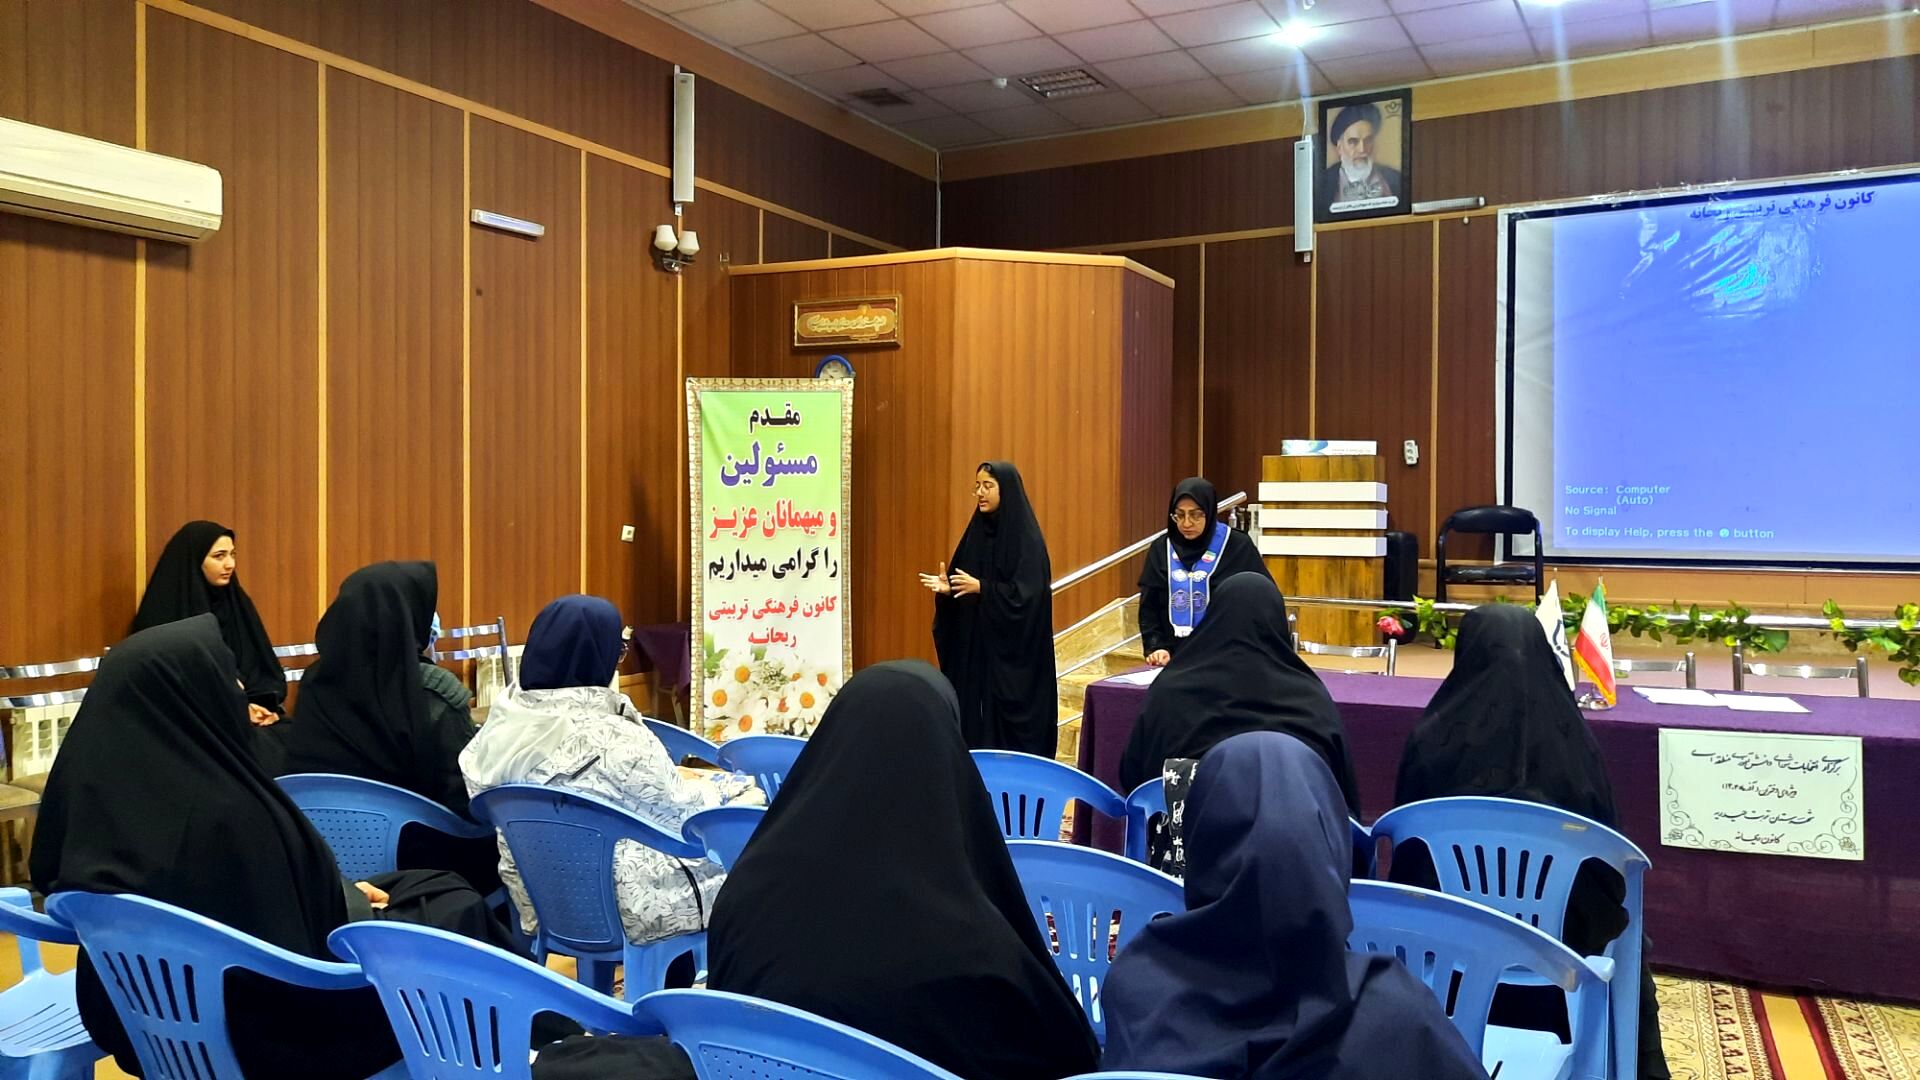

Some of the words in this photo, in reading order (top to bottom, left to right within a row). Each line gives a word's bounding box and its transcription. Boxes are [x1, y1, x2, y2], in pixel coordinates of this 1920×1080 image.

[1834, 191, 1875, 210] کانون
[749, 403, 801, 434] مقدم
[720, 441, 818, 486] مسئولین
[1565, 485, 1608, 495] Source:
[1616, 484, 1670, 496] Computer
[1616, 495, 1653, 505] (Auto)
[709, 506, 758, 538] عزیز
[762, 500, 824, 537] میهمانان
[1565, 506, 1580, 516] No
[1583, 506, 1617, 517] Signal
[828, 511, 837, 537] و
[1565, 527, 1578, 537] To
[1582, 527, 1620, 538] display
[1624, 527, 1653, 538] Help,
[1657, 529, 1689, 539] press
[1694, 528, 1713, 538] the
[1734, 529, 1774, 539] button
[709, 548, 767, 580] میداریم
[772, 546, 819, 579] گرامی
[824, 547, 838, 578] را
[709, 599, 749, 620] تربیتی
[752, 595, 799, 619] فرهنگی
[803, 596, 837, 618] کانون
[748, 627, 796, 647] ریحانه
[1760, 833, 1784, 844] کانون
